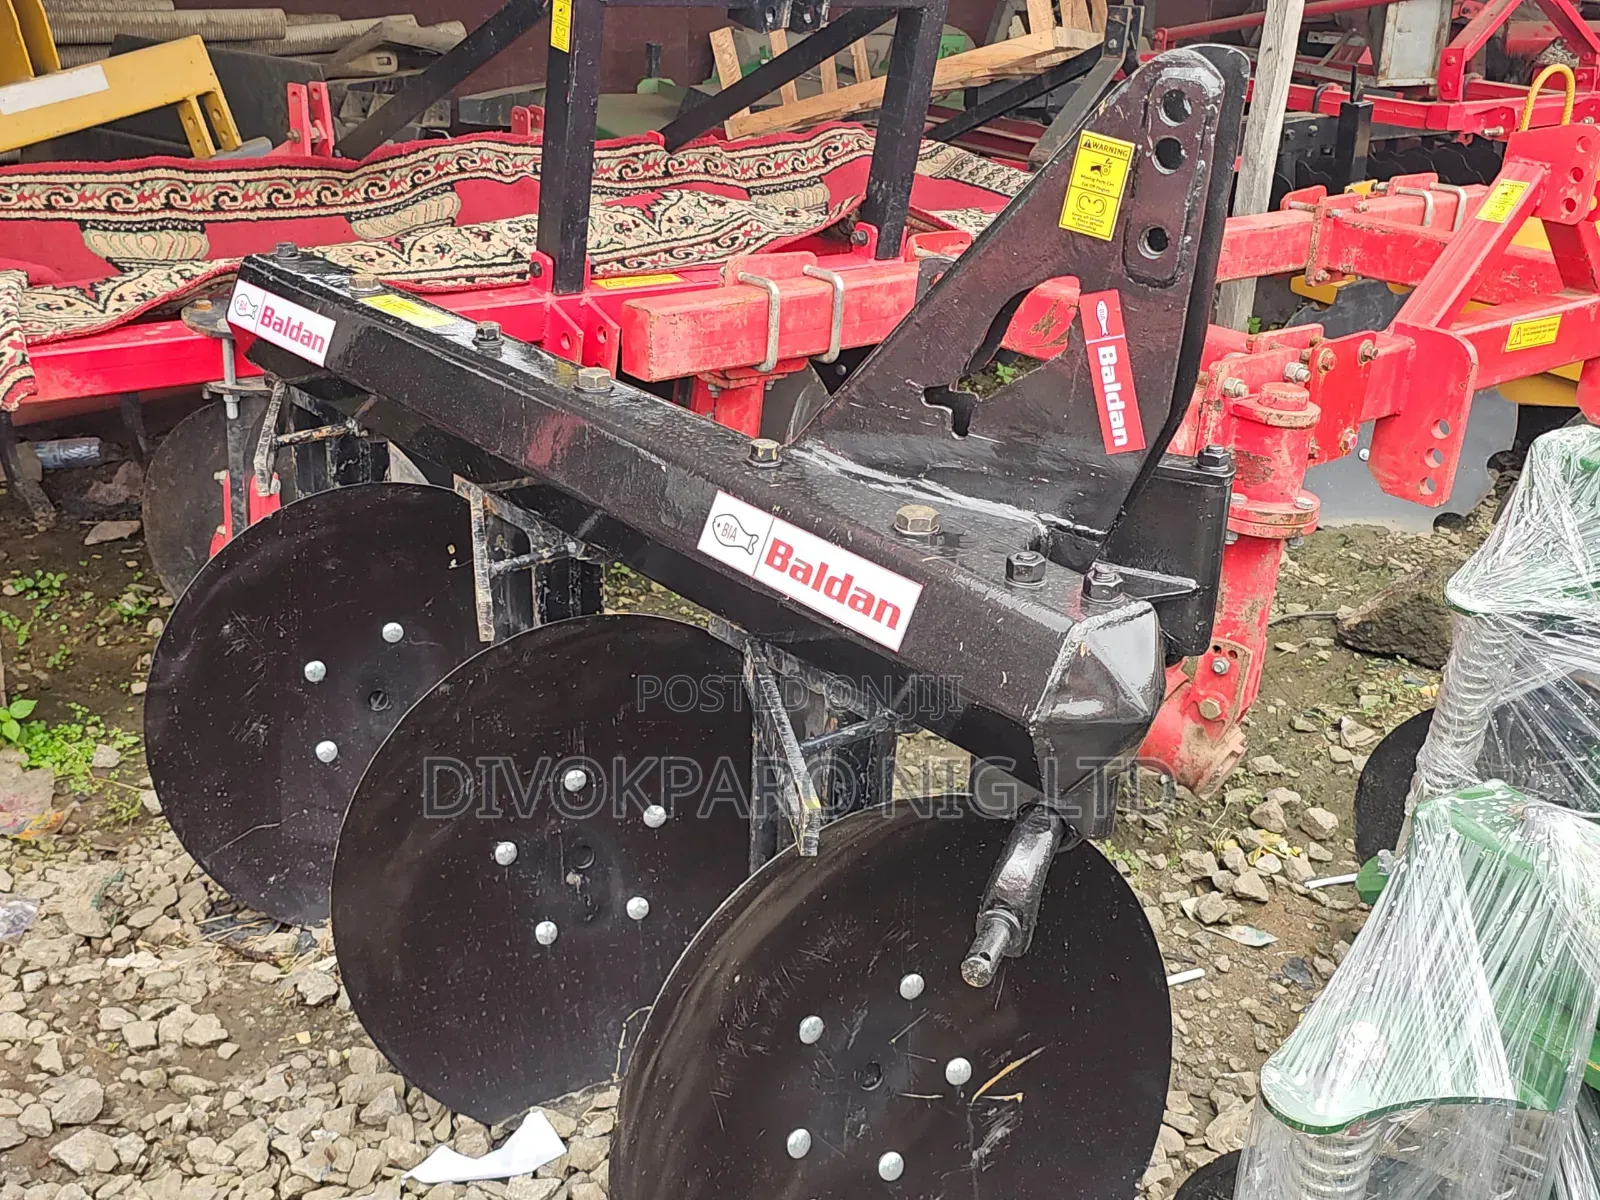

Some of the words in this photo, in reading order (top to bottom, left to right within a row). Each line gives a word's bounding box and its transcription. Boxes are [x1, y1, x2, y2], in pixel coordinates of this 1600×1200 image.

[1092, 140, 1129, 158] WARNING
[260, 305, 325, 353] Baldan
[1097, 345, 1128, 447] Baldan
[720, 522, 738, 542] BIA
[764, 537, 901, 630] Baldan
